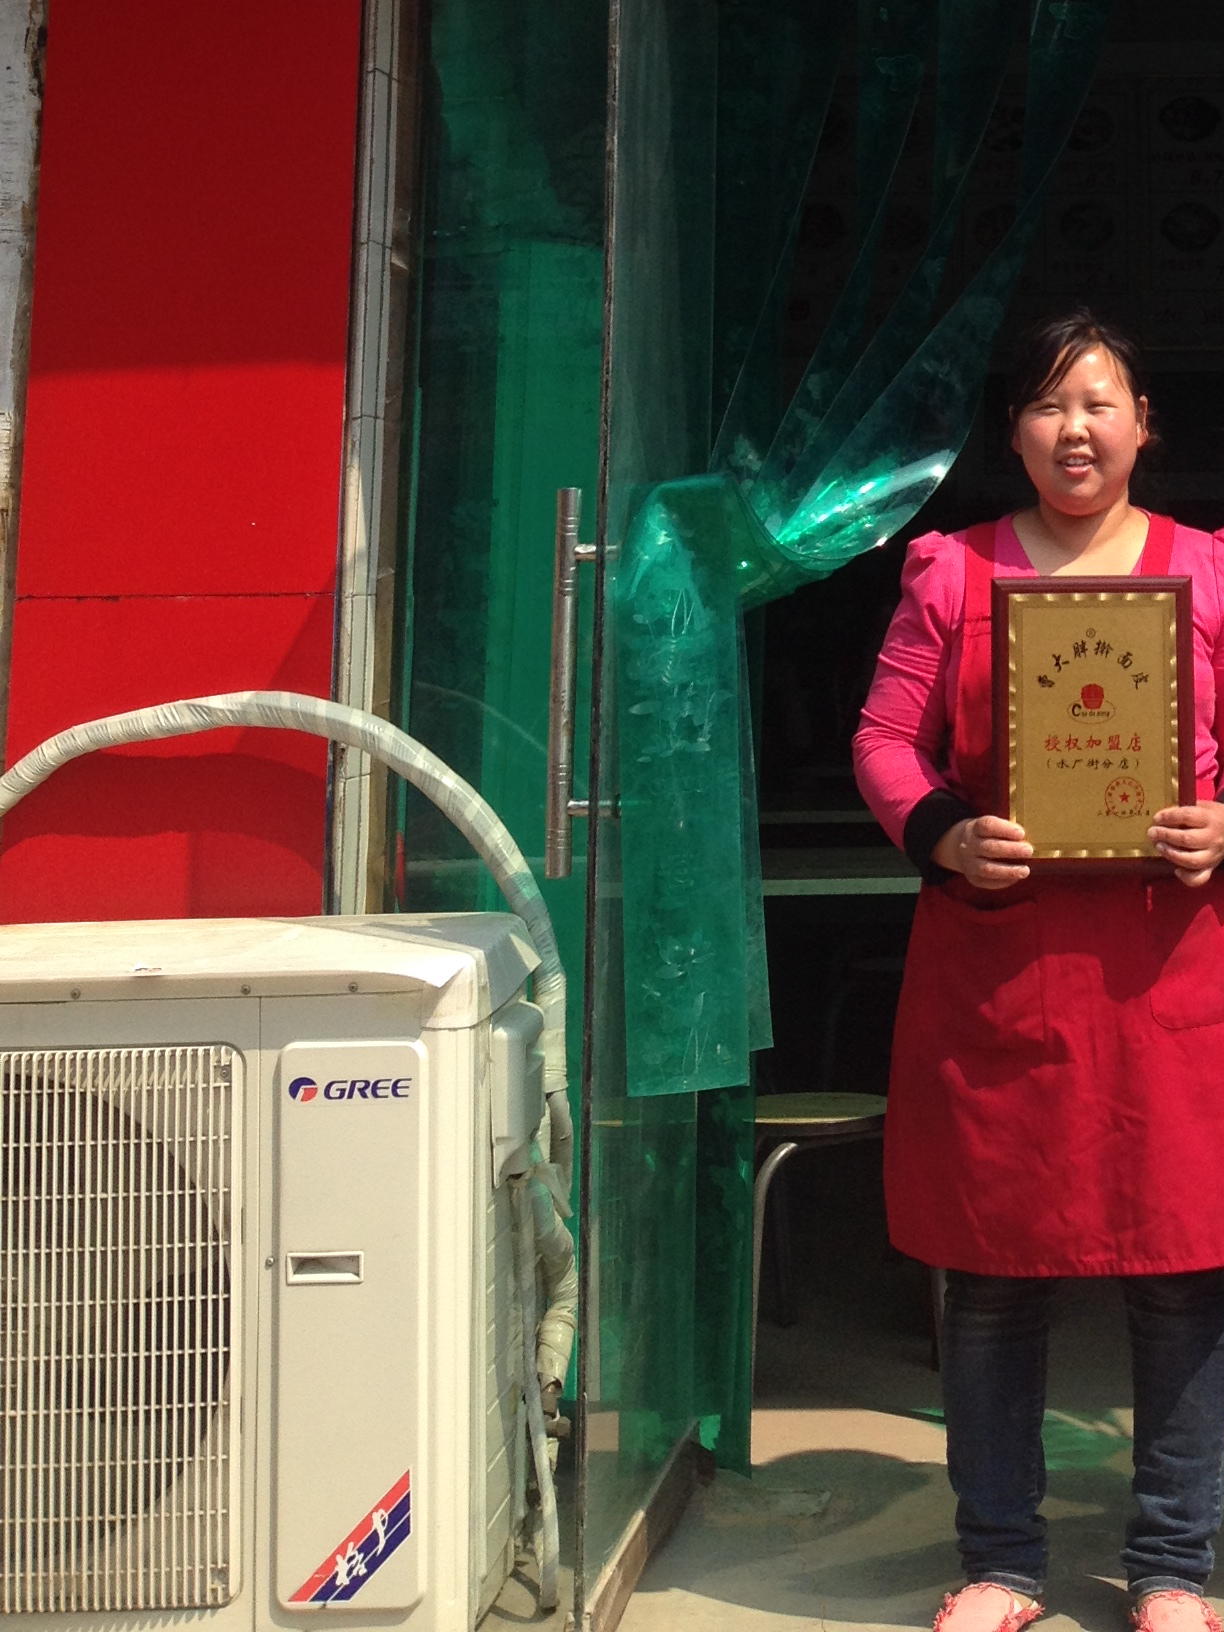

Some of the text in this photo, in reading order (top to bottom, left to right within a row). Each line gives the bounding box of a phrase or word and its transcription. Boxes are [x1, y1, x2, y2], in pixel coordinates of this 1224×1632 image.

[1044, 732, 1142, 752] 授权加盟店
[323, 1077, 413, 1101] GREE
